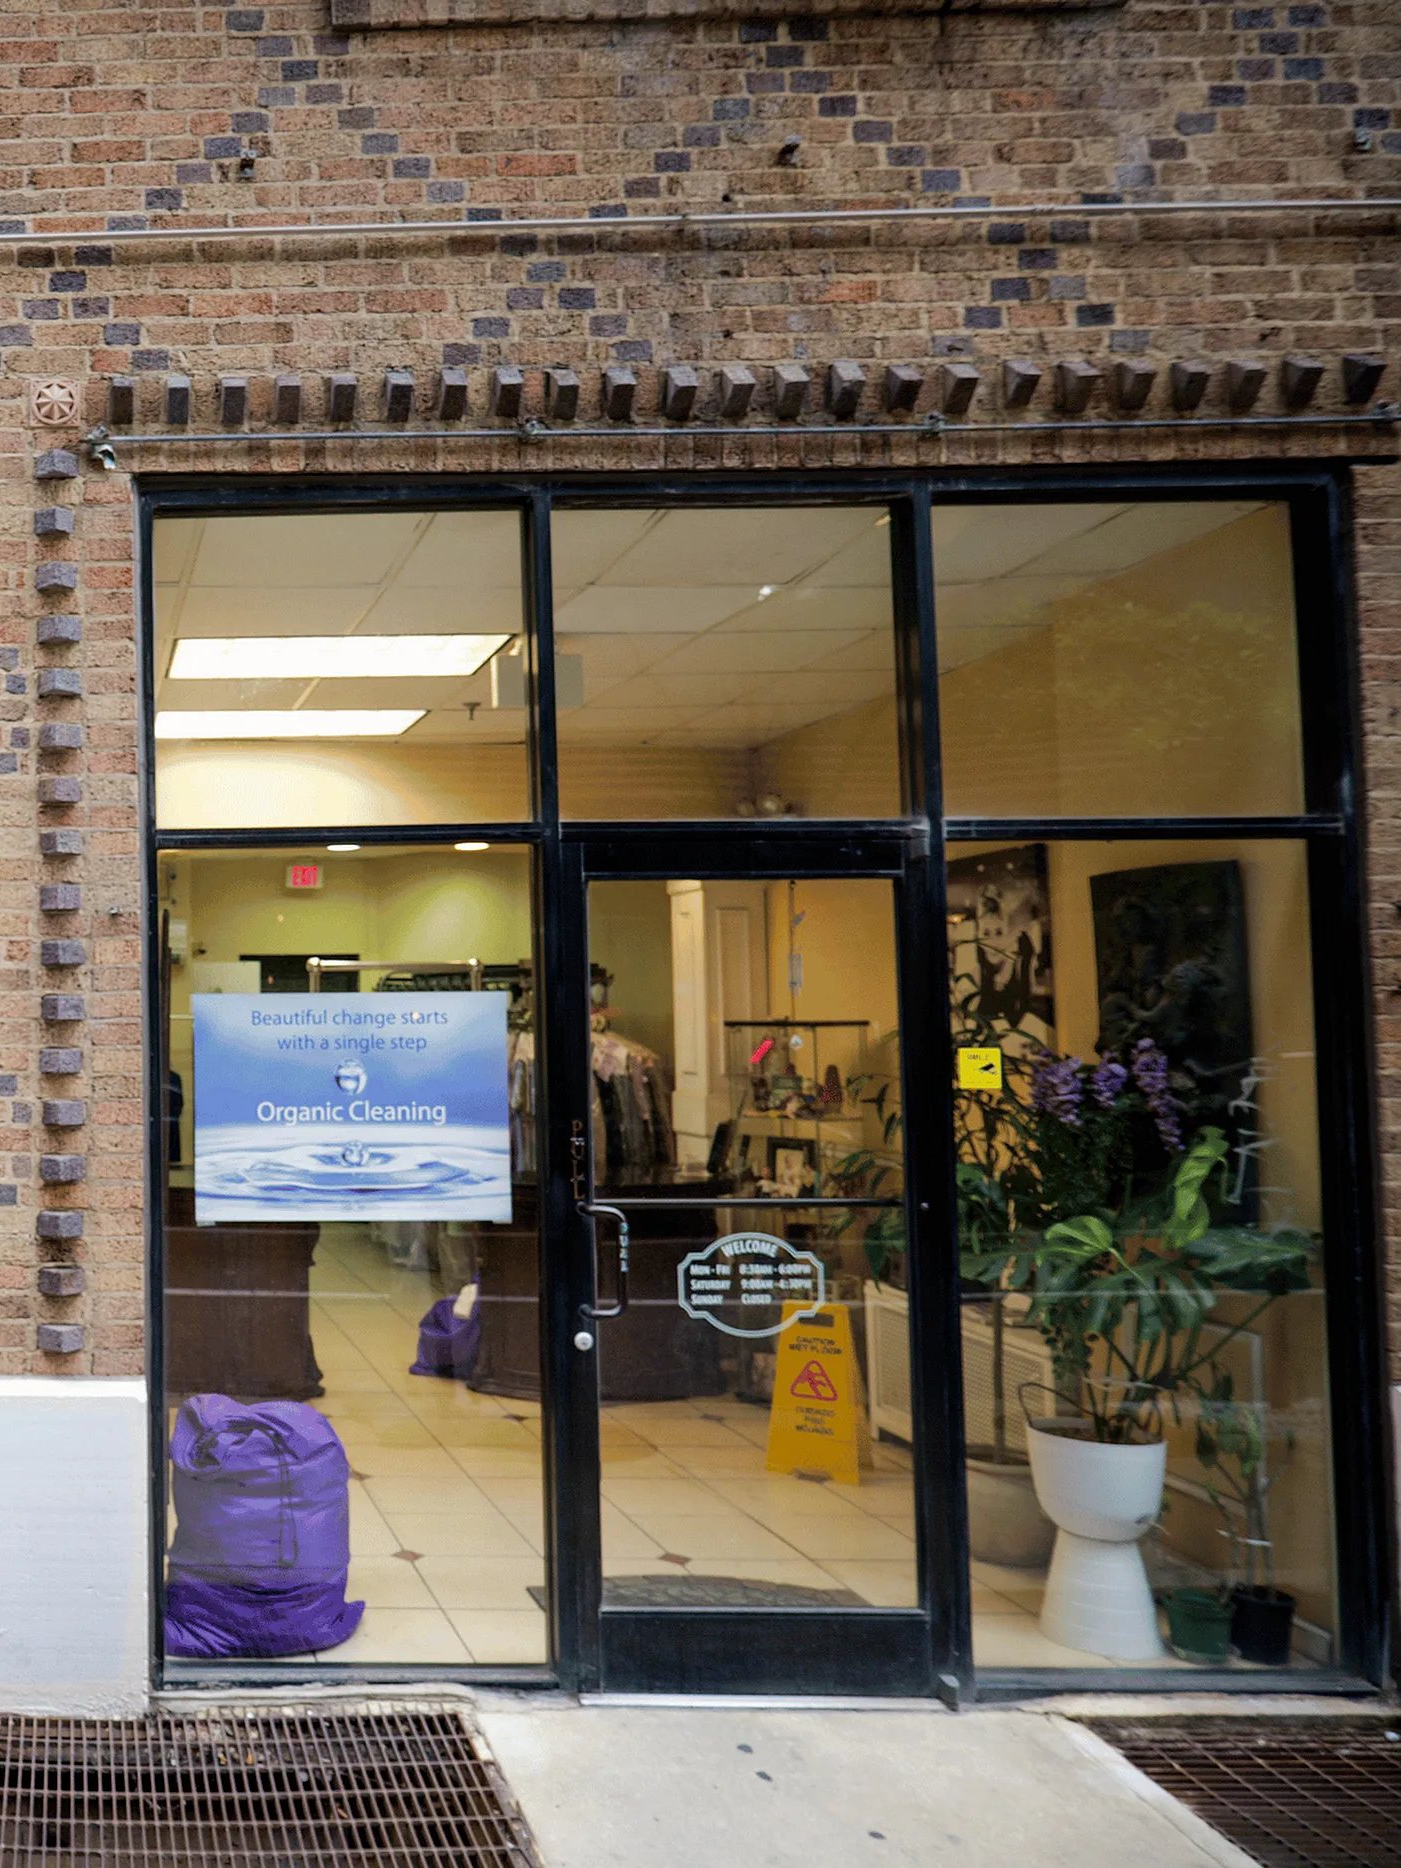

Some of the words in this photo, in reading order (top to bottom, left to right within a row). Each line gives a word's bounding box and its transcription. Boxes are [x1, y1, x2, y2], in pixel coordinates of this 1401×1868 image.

[251, 1009, 328, 1026] Beautiful
[332, 1009, 397, 1028] change
[401, 1011, 448, 1025] starts
[277, 1034, 315, 1050] with
[319, 1039, 329, 1050] a
[333, 1034, 386, 1053] single
[390, 1036, 427, 1052] step
[256, 1101, 344, 1126] Organic
[348, 1101, 447, 1125] Cleaning
[570, 1119, 586, 1200] PULL
[721, 1240, 779, 1258] WELCOME
[690, 1264, 711, 1276] MON
[690, 1279, 732, 1290] SATURDAY
[691, 1294, 724, 1305] SUNDAY
[741, 1293, 772, 1305] CLOSED
